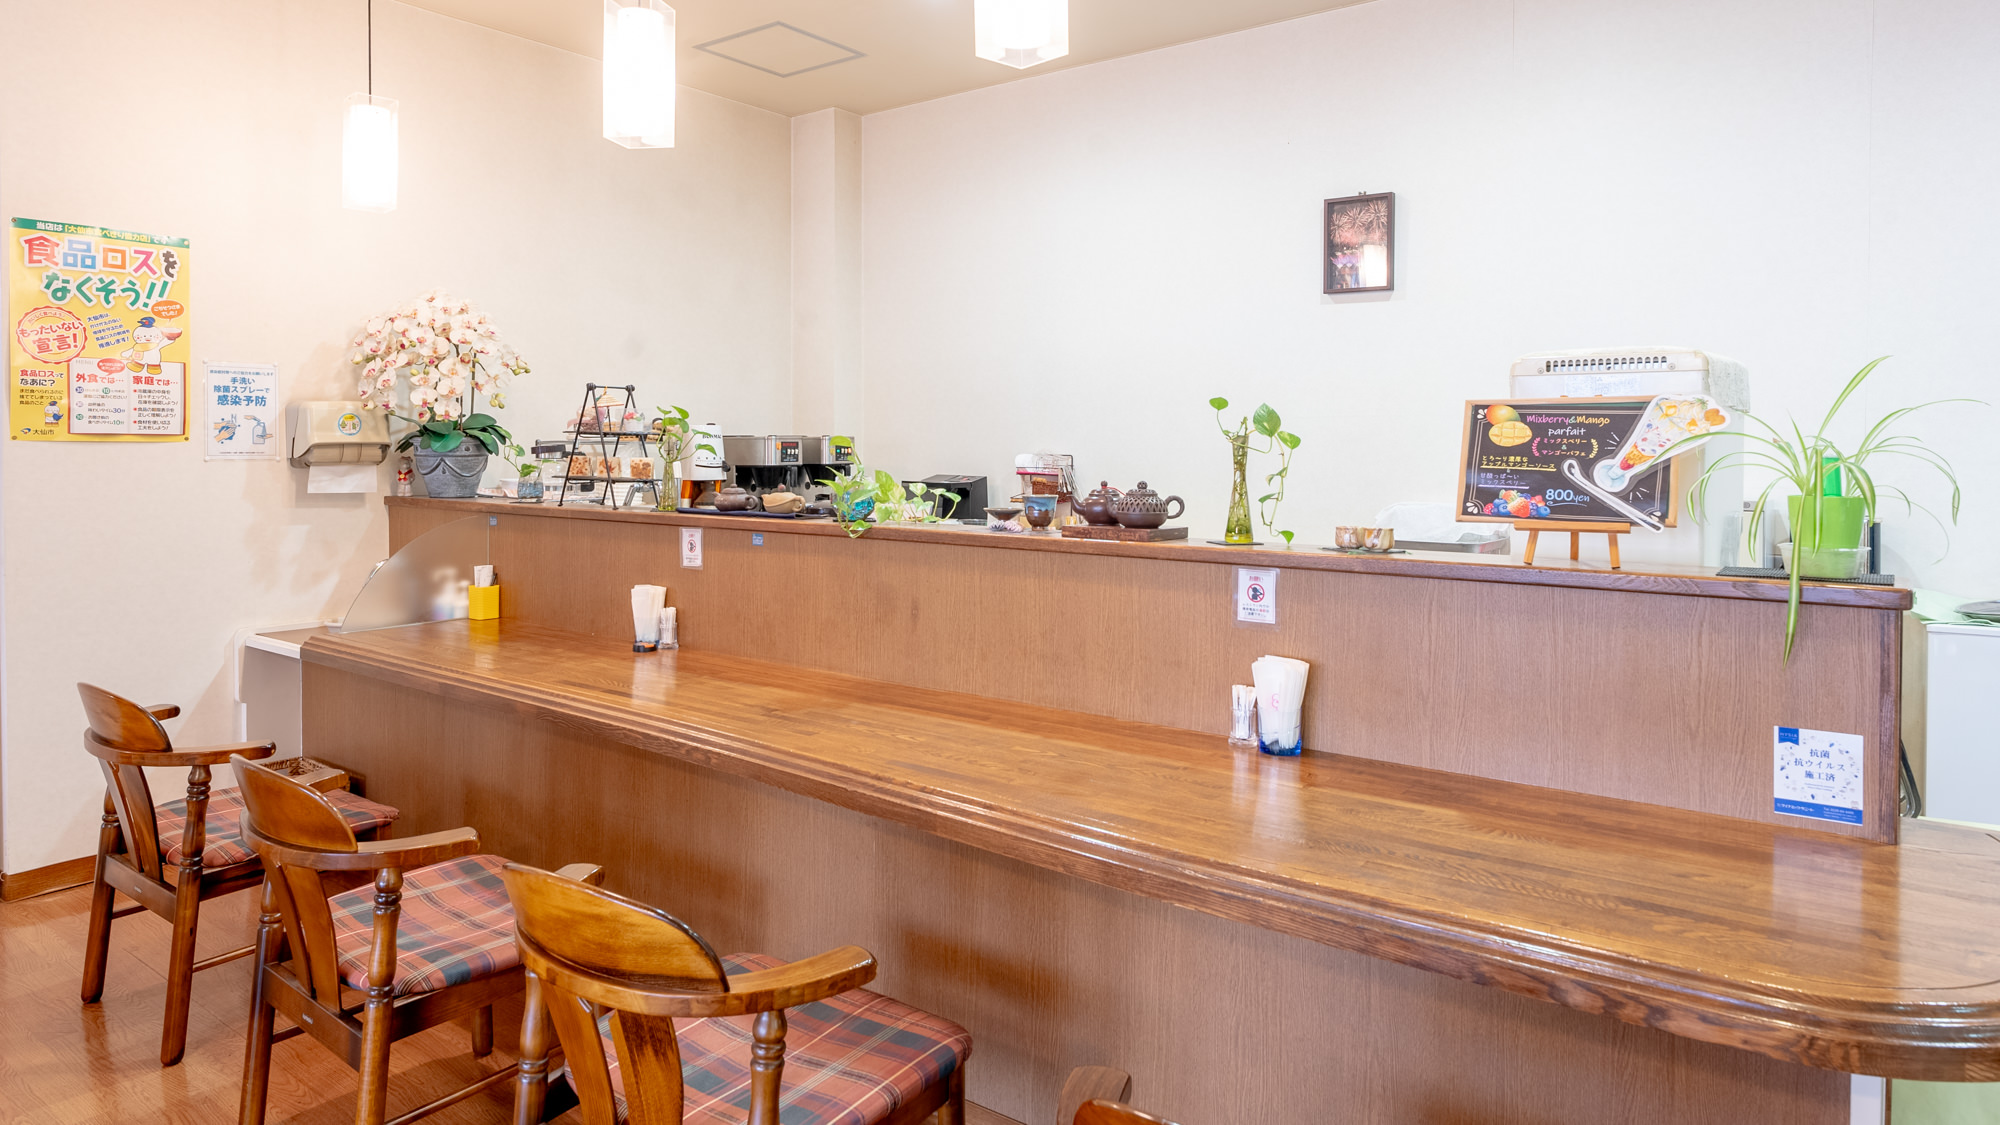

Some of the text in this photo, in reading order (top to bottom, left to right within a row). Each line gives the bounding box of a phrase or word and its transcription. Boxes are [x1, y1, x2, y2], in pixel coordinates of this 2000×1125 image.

[24, 235, 178, 279] 食品ロスを
[43, 271, 169, 308] なくそう!!
[18, 320, 83, 338] もったいない
[32, 332, 78, 354] 宣言!
[20, 368, 64, 379] 食品ロスって
[20, 378, 55, 387] なあに?
[230, 376, 256, 385] 手洗い
[213, 384, 271, 394] 除菌スプレーで
[217, 394, 268, 407] 感染予防
[1526, 414, 1611, 428] Mixberry&Mango
[1548, 426, 1587, 437] parfait
[1542, 437, 1588, 445] ミックスベリー
[1541, 449, 1587, 457] マンゴーパフェ
[1481, 461, 1556, 469] アップルマンゴーソース
[1480, 478, 1528, 486] ミックスベリー
[1545, 488, 1591, 503] 800yen
[1809, 748, 1831, 759] 抗菌
[1794, 757, 1846, 772] 抗ウイルス
[1804, 769, 1836, 782] 施工済
